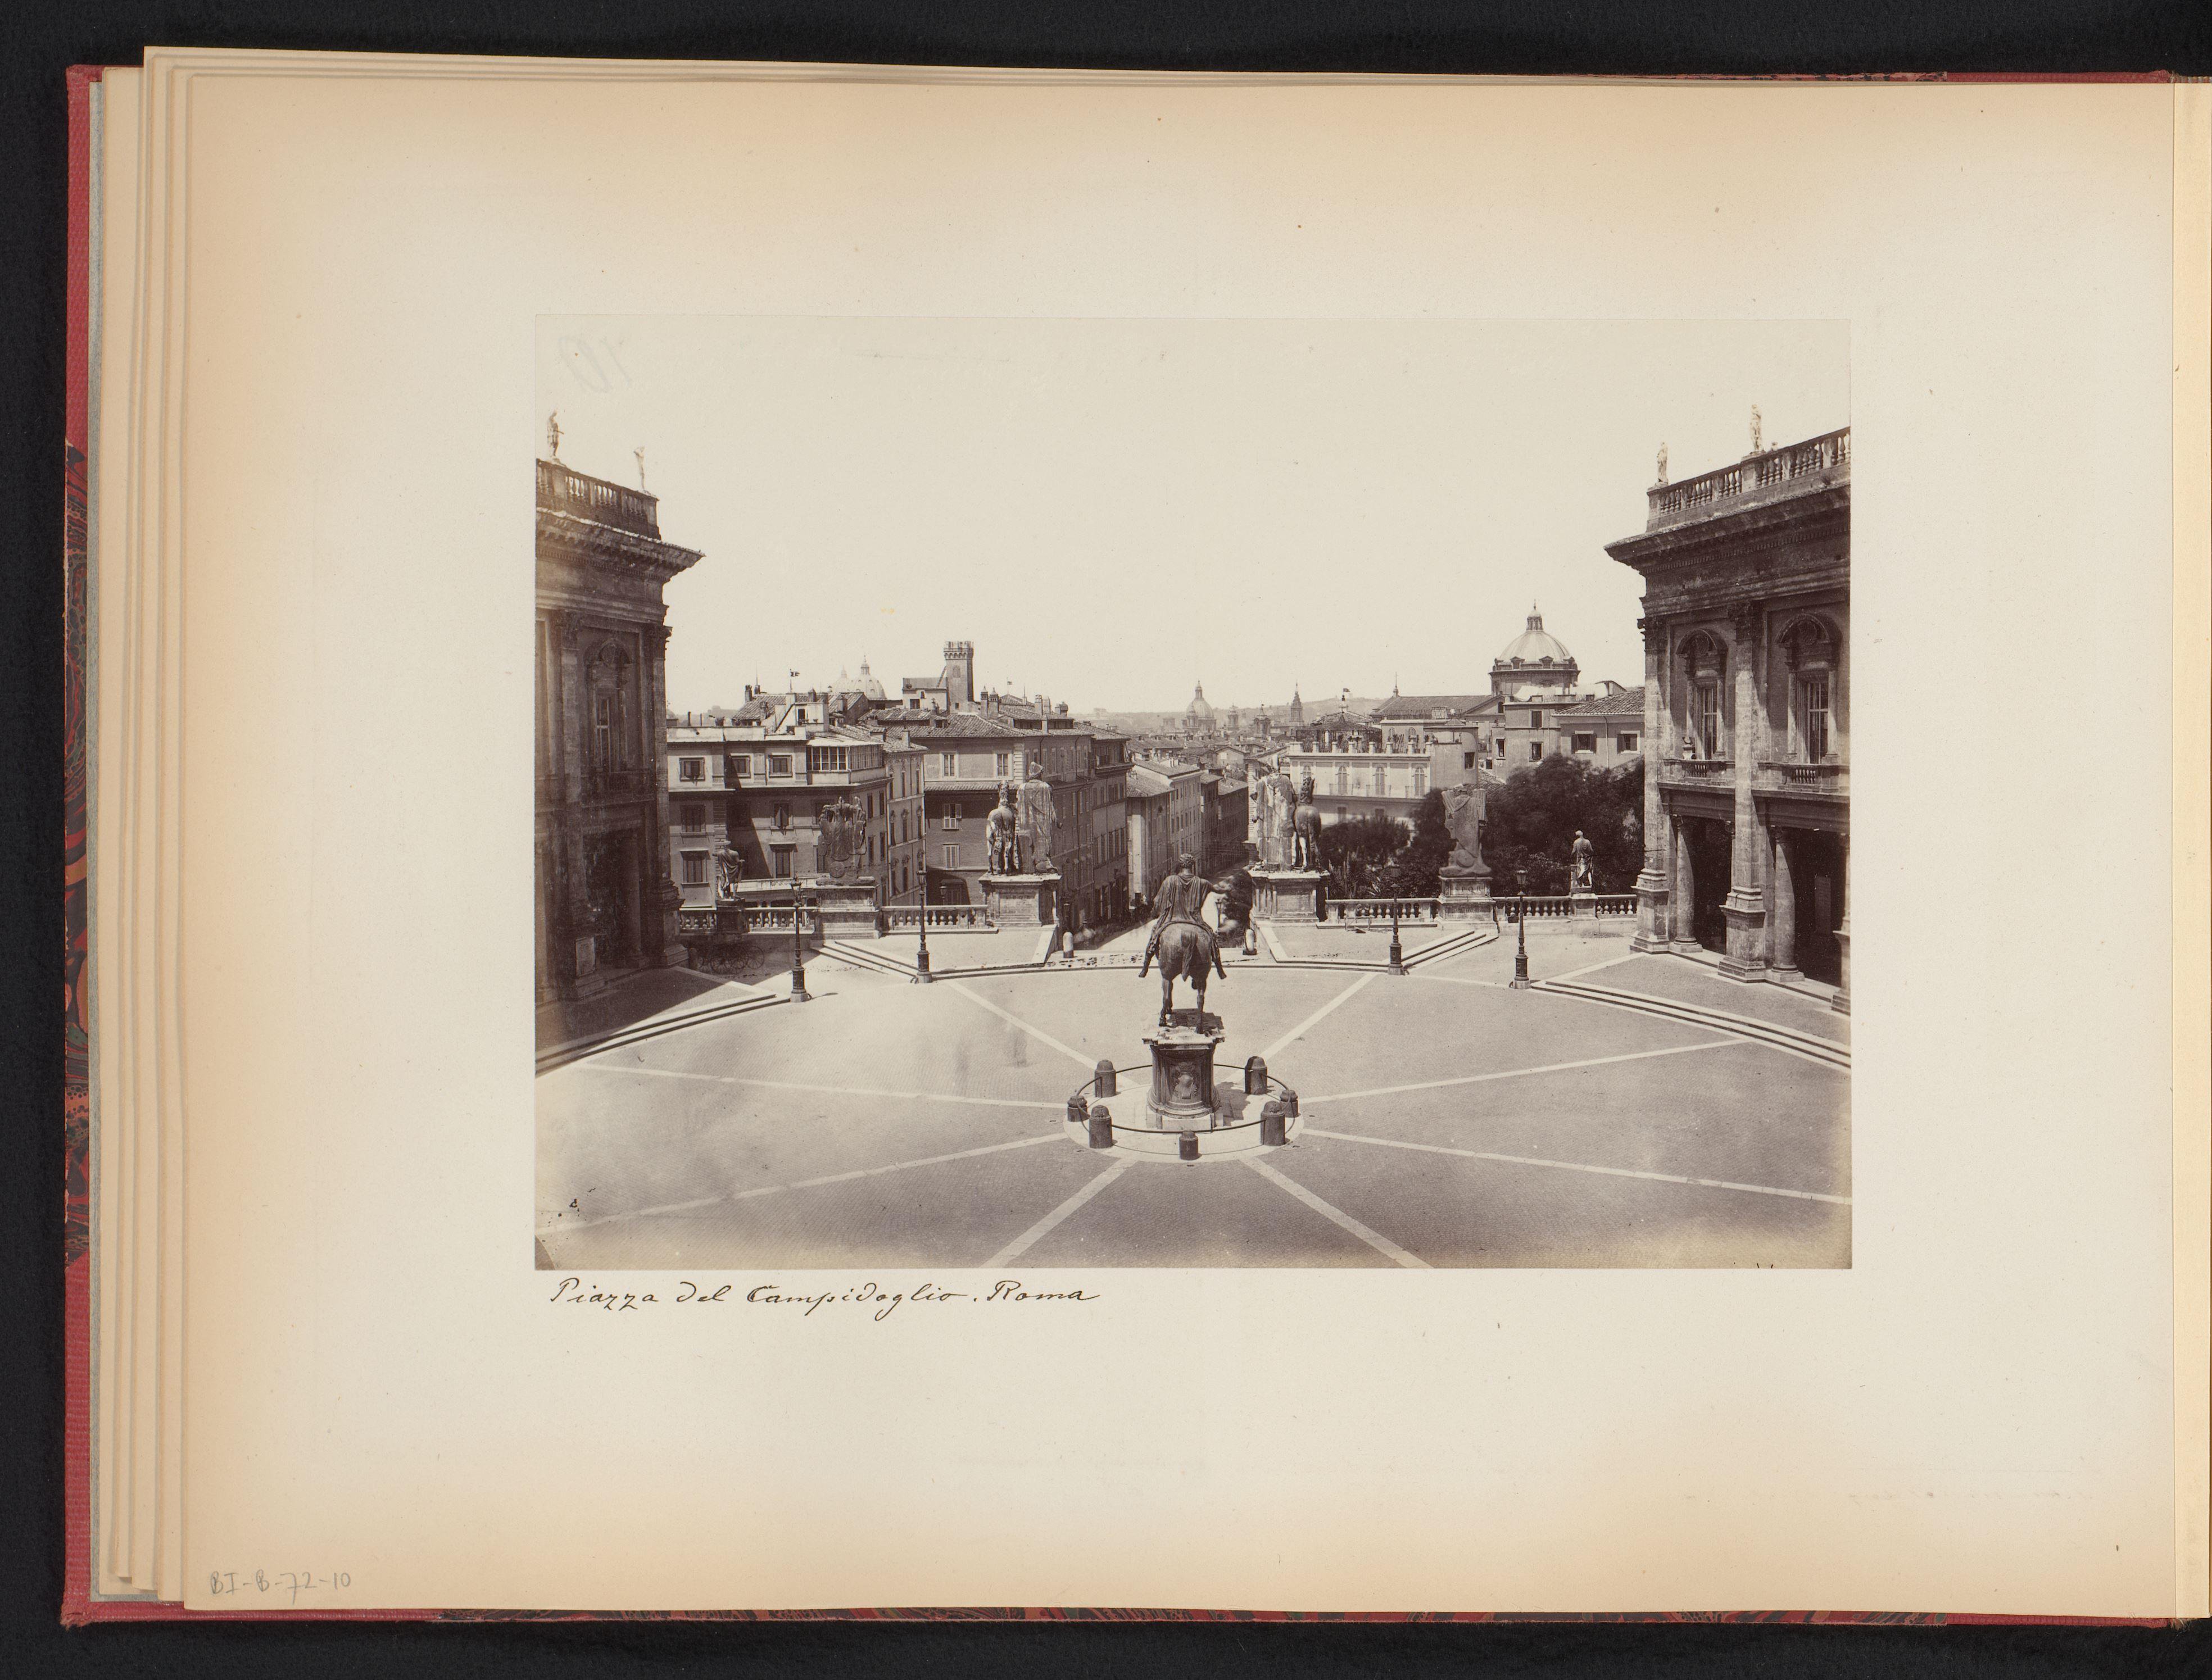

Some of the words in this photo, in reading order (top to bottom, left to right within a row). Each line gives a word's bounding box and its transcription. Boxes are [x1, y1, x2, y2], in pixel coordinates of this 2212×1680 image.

[550, 1277, 659, 1312] Piazza
[676, 1281, 732, 1303] del
[986, 1279, 1102, 1303] Roma
[210, 1569, 352, 1606] BI-B-72-10
